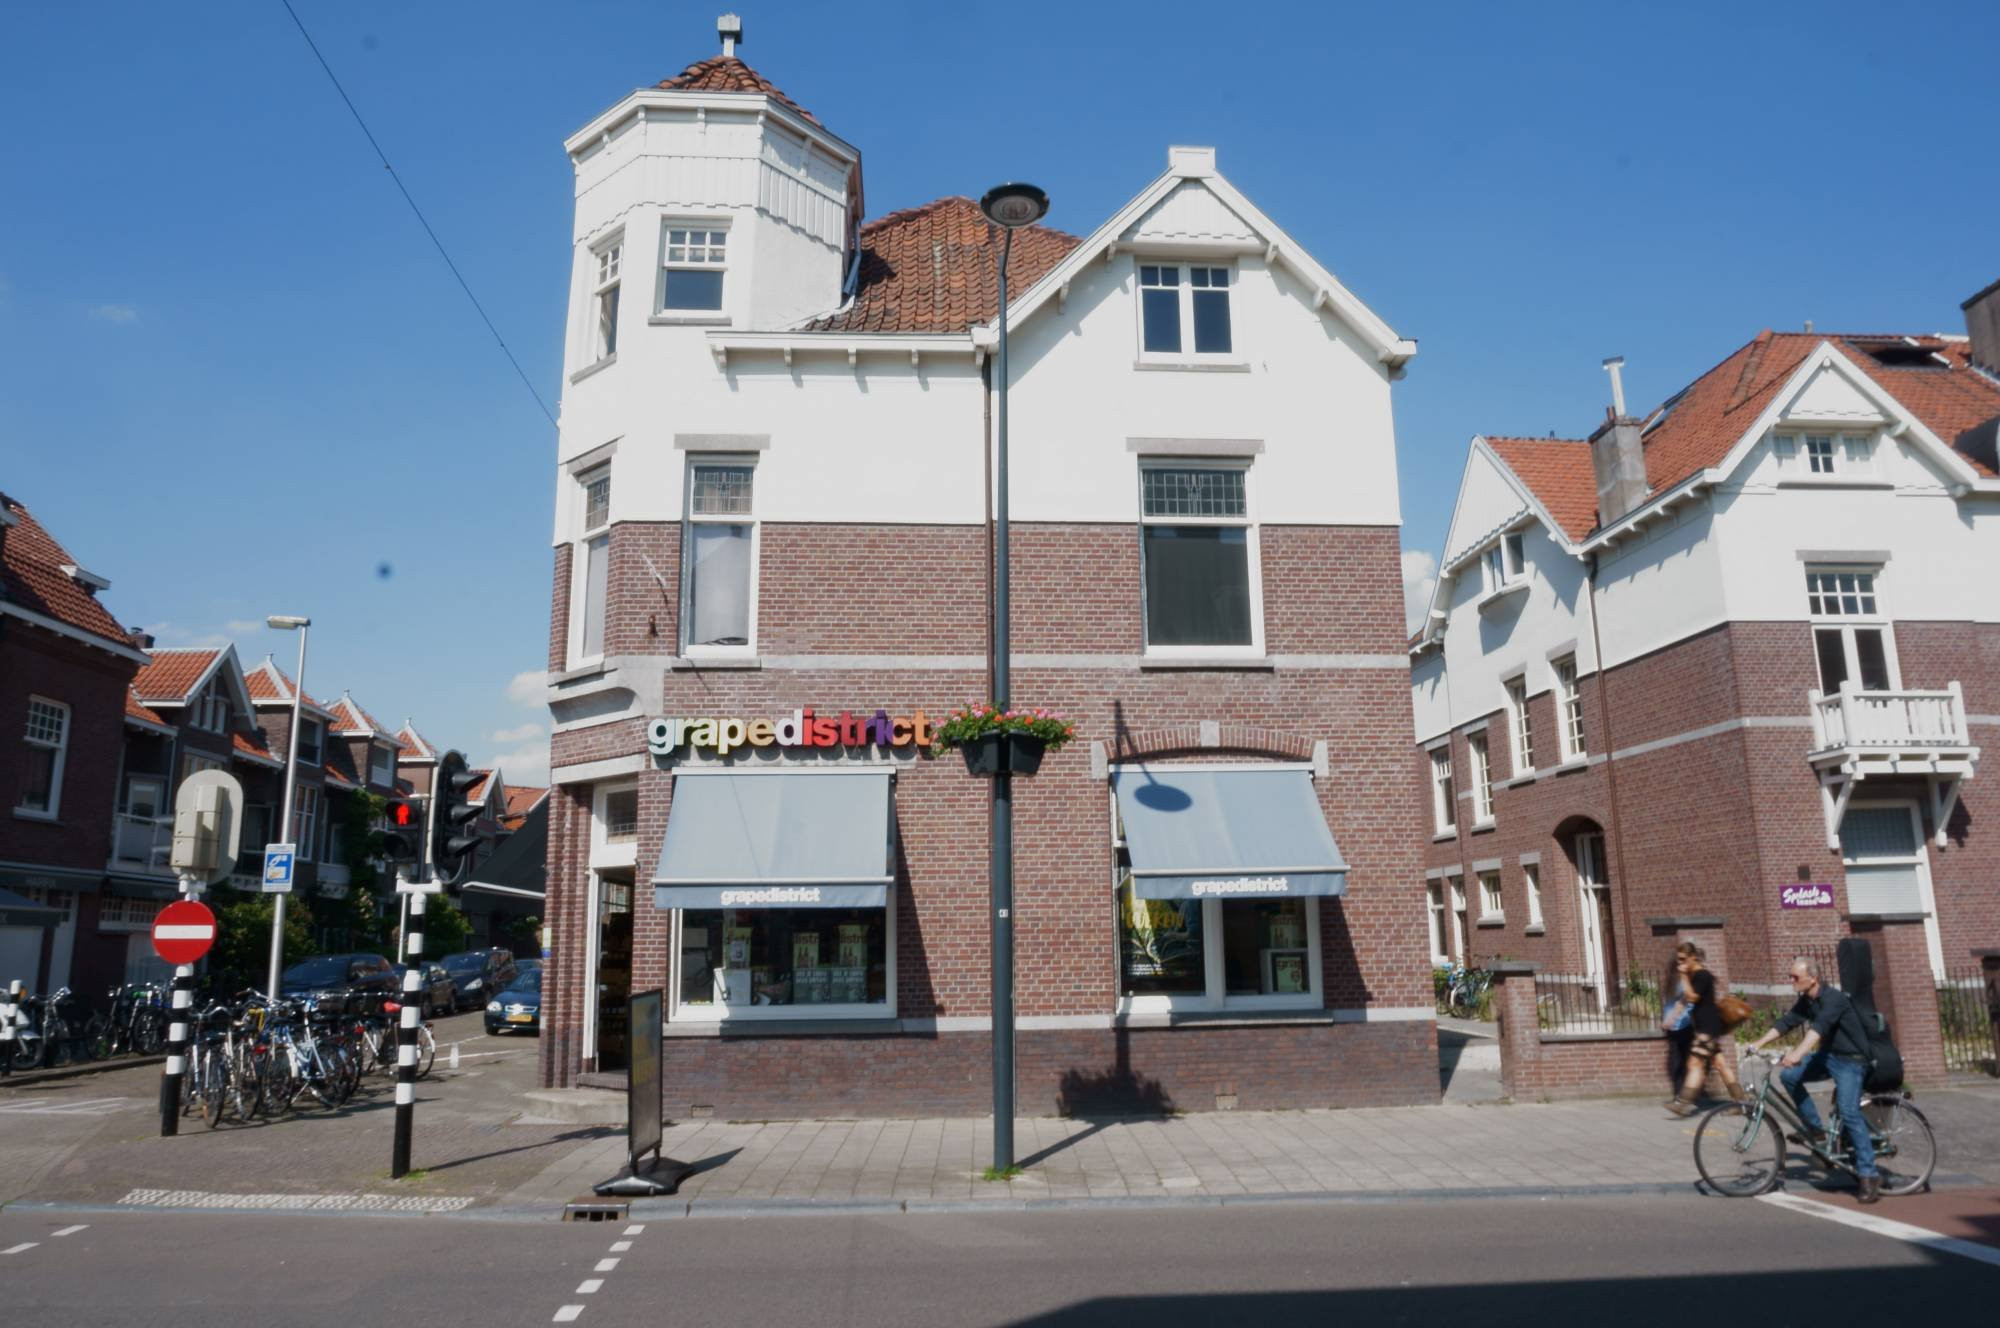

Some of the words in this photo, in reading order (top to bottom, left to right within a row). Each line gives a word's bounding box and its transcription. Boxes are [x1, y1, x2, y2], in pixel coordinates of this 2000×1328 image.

[648, 709, 931, 754] grapedistrict
[1192, 877, 1288, 895] grapedistrict
[721, 887, 820, 905] grapedistrict
